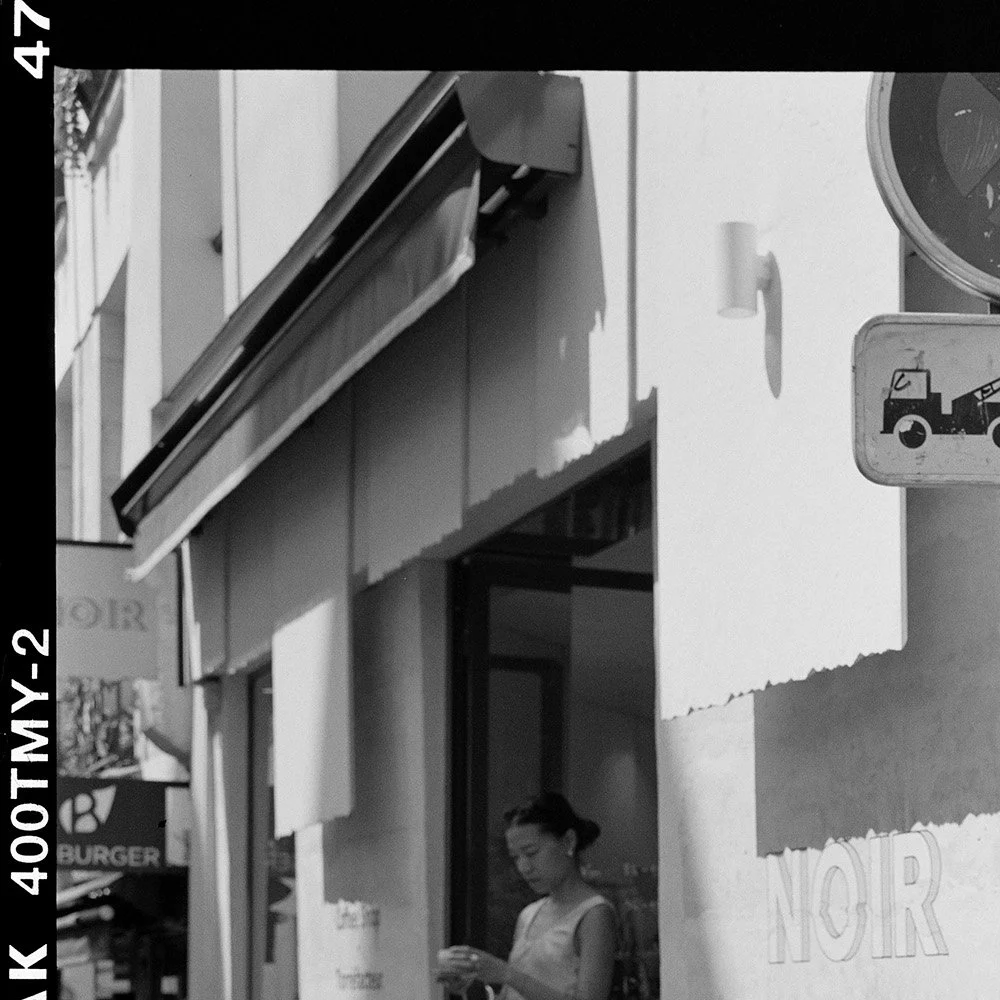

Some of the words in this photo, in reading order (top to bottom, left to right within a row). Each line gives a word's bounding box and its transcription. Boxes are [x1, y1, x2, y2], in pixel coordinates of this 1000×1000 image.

[13, 0, 51, 80] 47
[57, 596, 148, 631] OIR
[10, 628, 50, 896] 400TMY-2
[57, 843, 160, 867] BURGER
[765, 829, 949, 964] NOIR
